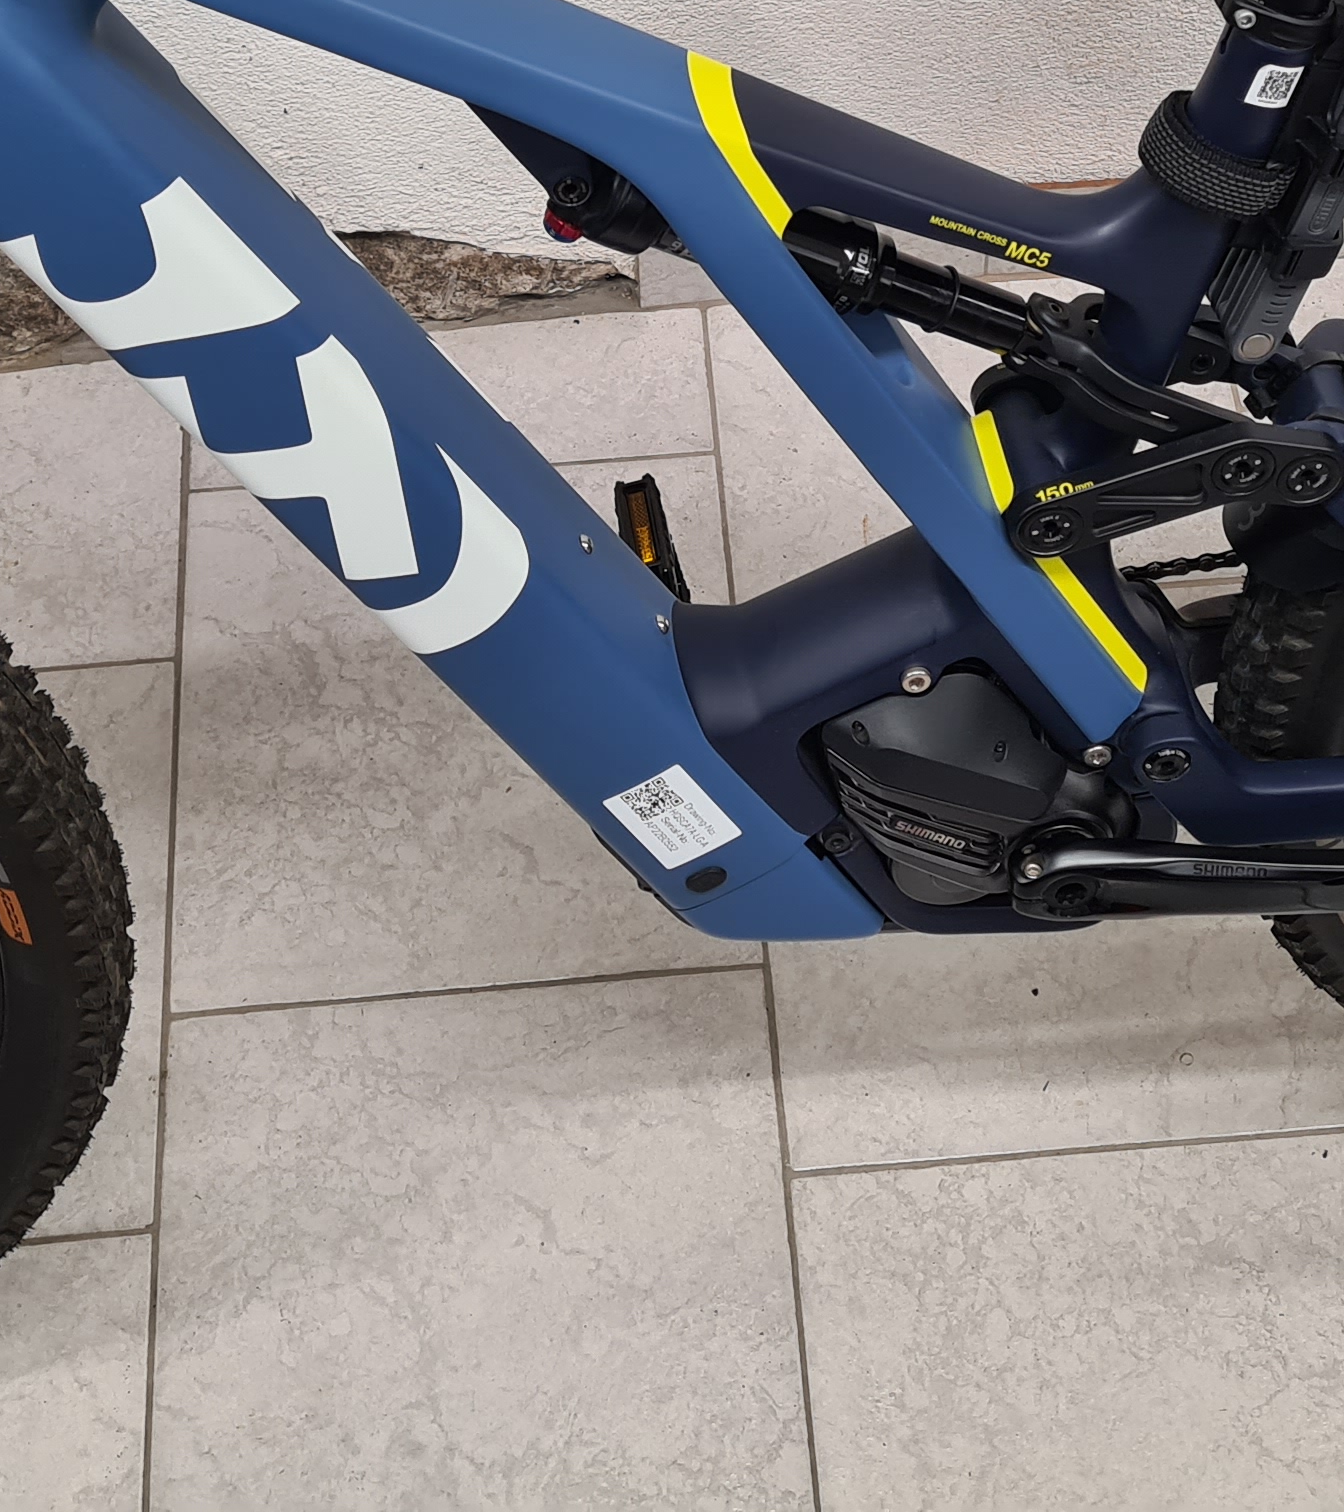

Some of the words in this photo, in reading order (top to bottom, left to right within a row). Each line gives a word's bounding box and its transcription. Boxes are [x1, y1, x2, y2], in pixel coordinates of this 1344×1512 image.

[929, 215, 977, 237] MOUNTAIN
[977, 231, 1008, 247] CROSS
[1005, 241, 1052, 268] MC5
[895, 820, 967, 849] SHIMANO
